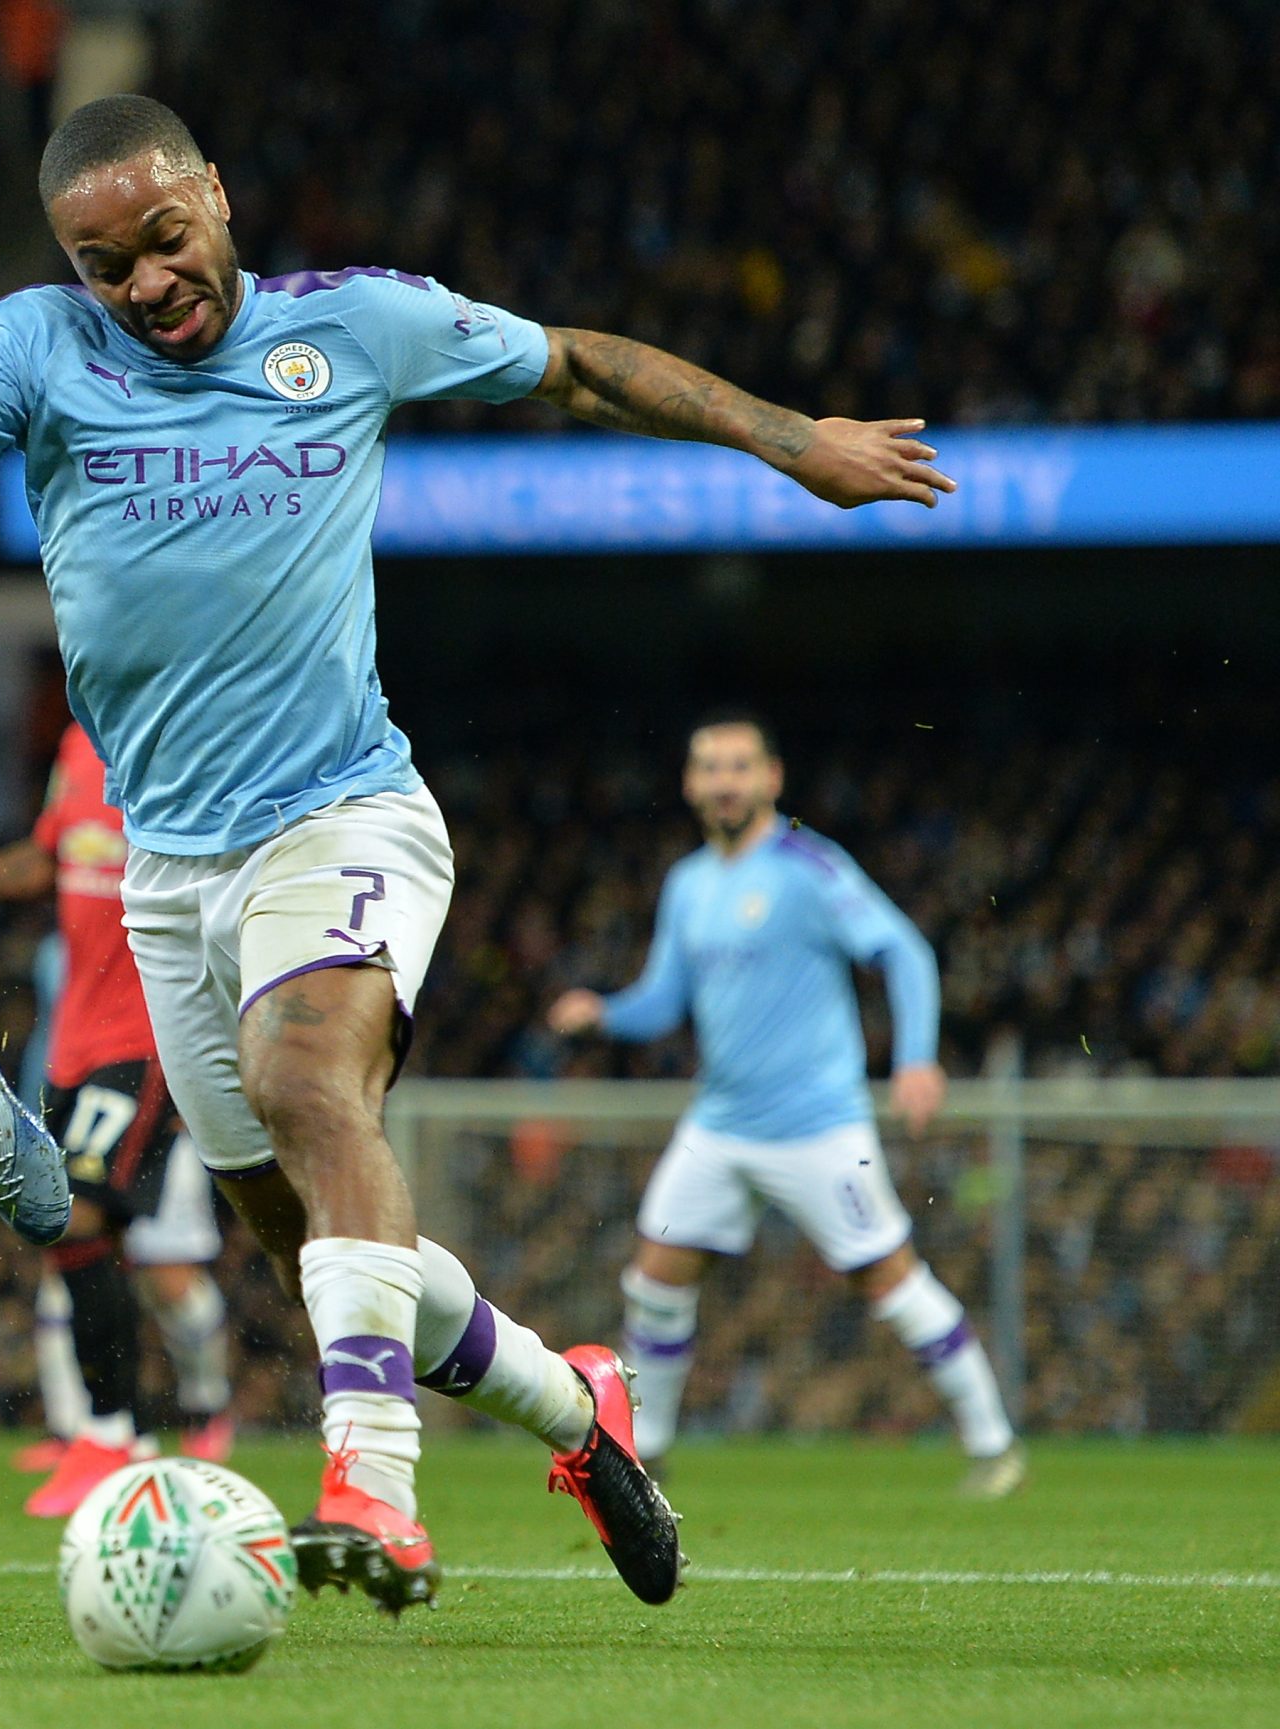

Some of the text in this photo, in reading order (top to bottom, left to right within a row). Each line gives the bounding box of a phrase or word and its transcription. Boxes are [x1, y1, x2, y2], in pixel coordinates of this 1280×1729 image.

[267, 344, 320, 370] MANCHESTER
[284, 405, 301, 414] 125
[296, 391, 315, 399] CITY
[83, 442, 347, 485] ETIHAD
[122, 492, 302, 521] AIRWAYS
[340, 869, 385, 930] 7
[63, 1084, 138, 1158] 17
